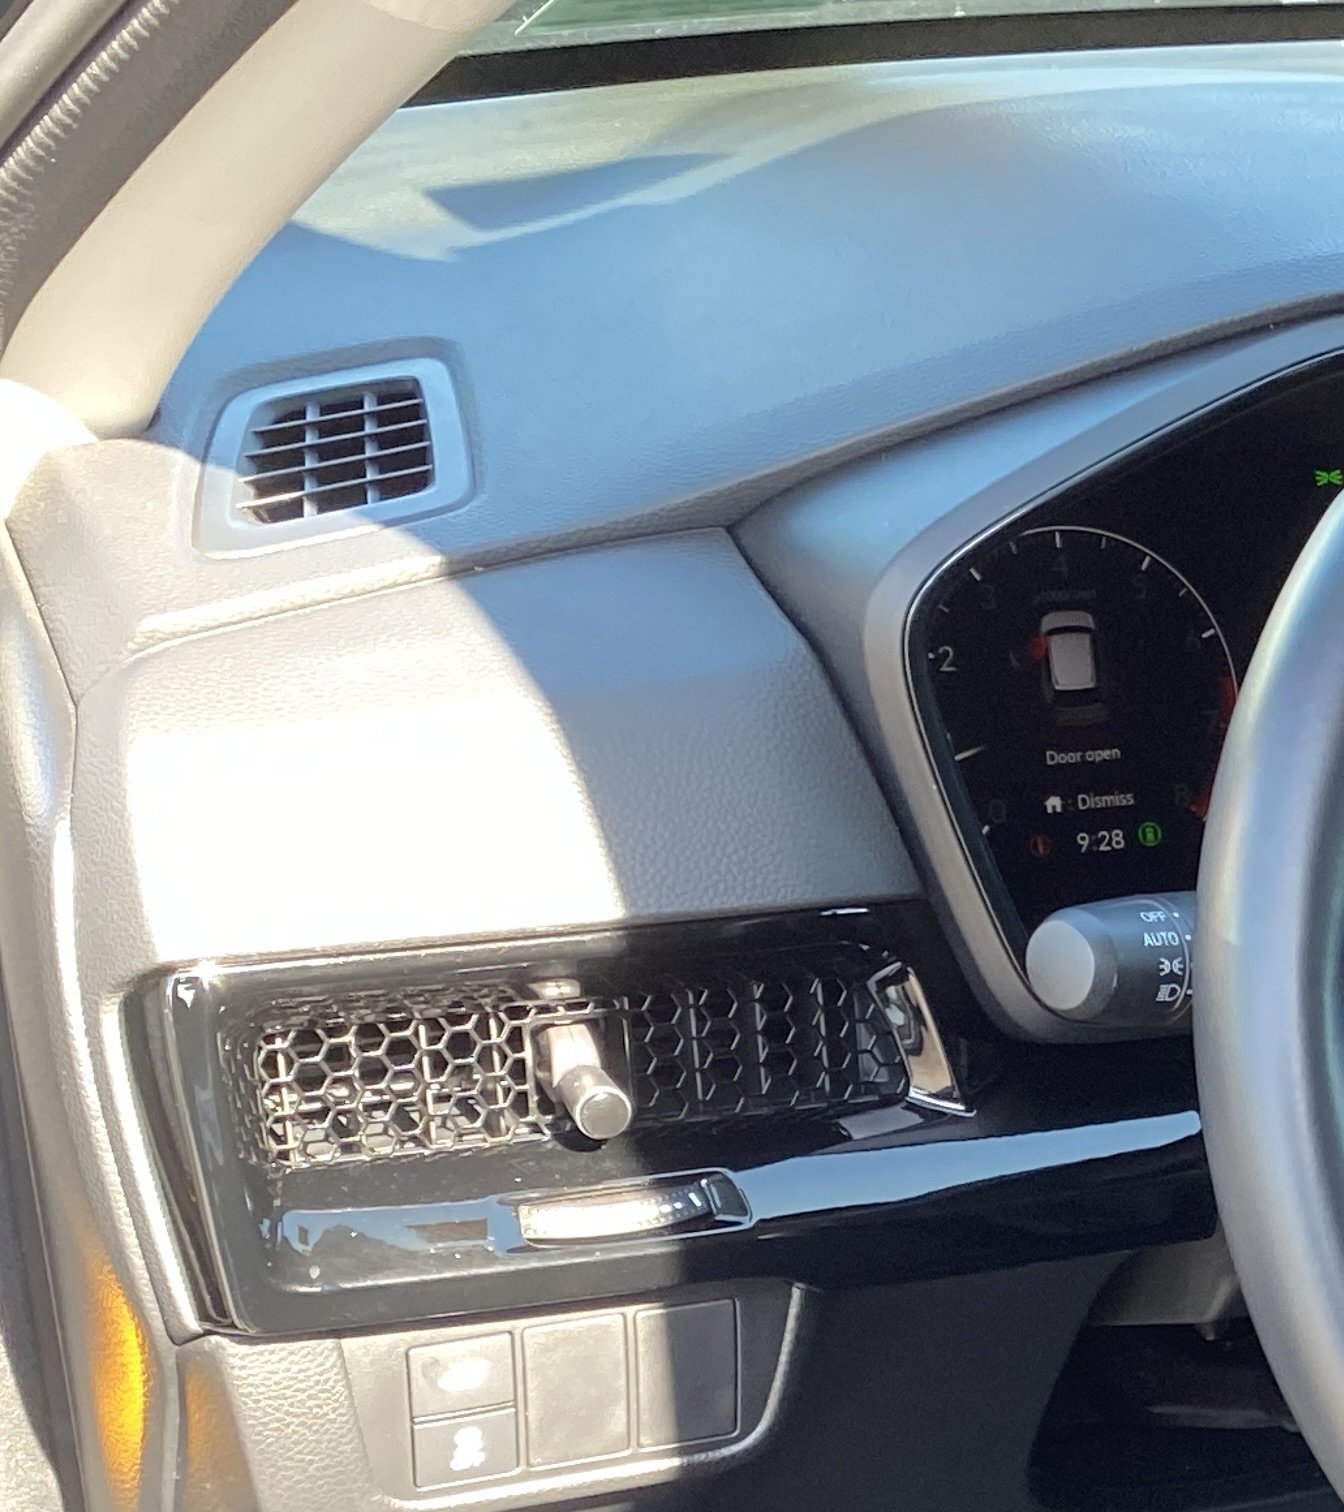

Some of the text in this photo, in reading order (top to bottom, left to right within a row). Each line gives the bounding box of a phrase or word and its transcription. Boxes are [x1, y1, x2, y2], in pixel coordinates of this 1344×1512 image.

[937, 645, 957, 672] 2
[1045, 747, 1122, 767] Door open
[1076, 791, 1135, 812] Dismiss
[1075, 828, 1126, 854] 9:28
[1139, 910, 1167, 923] OFF
[1143, 931, 1180, 947] AUTO
